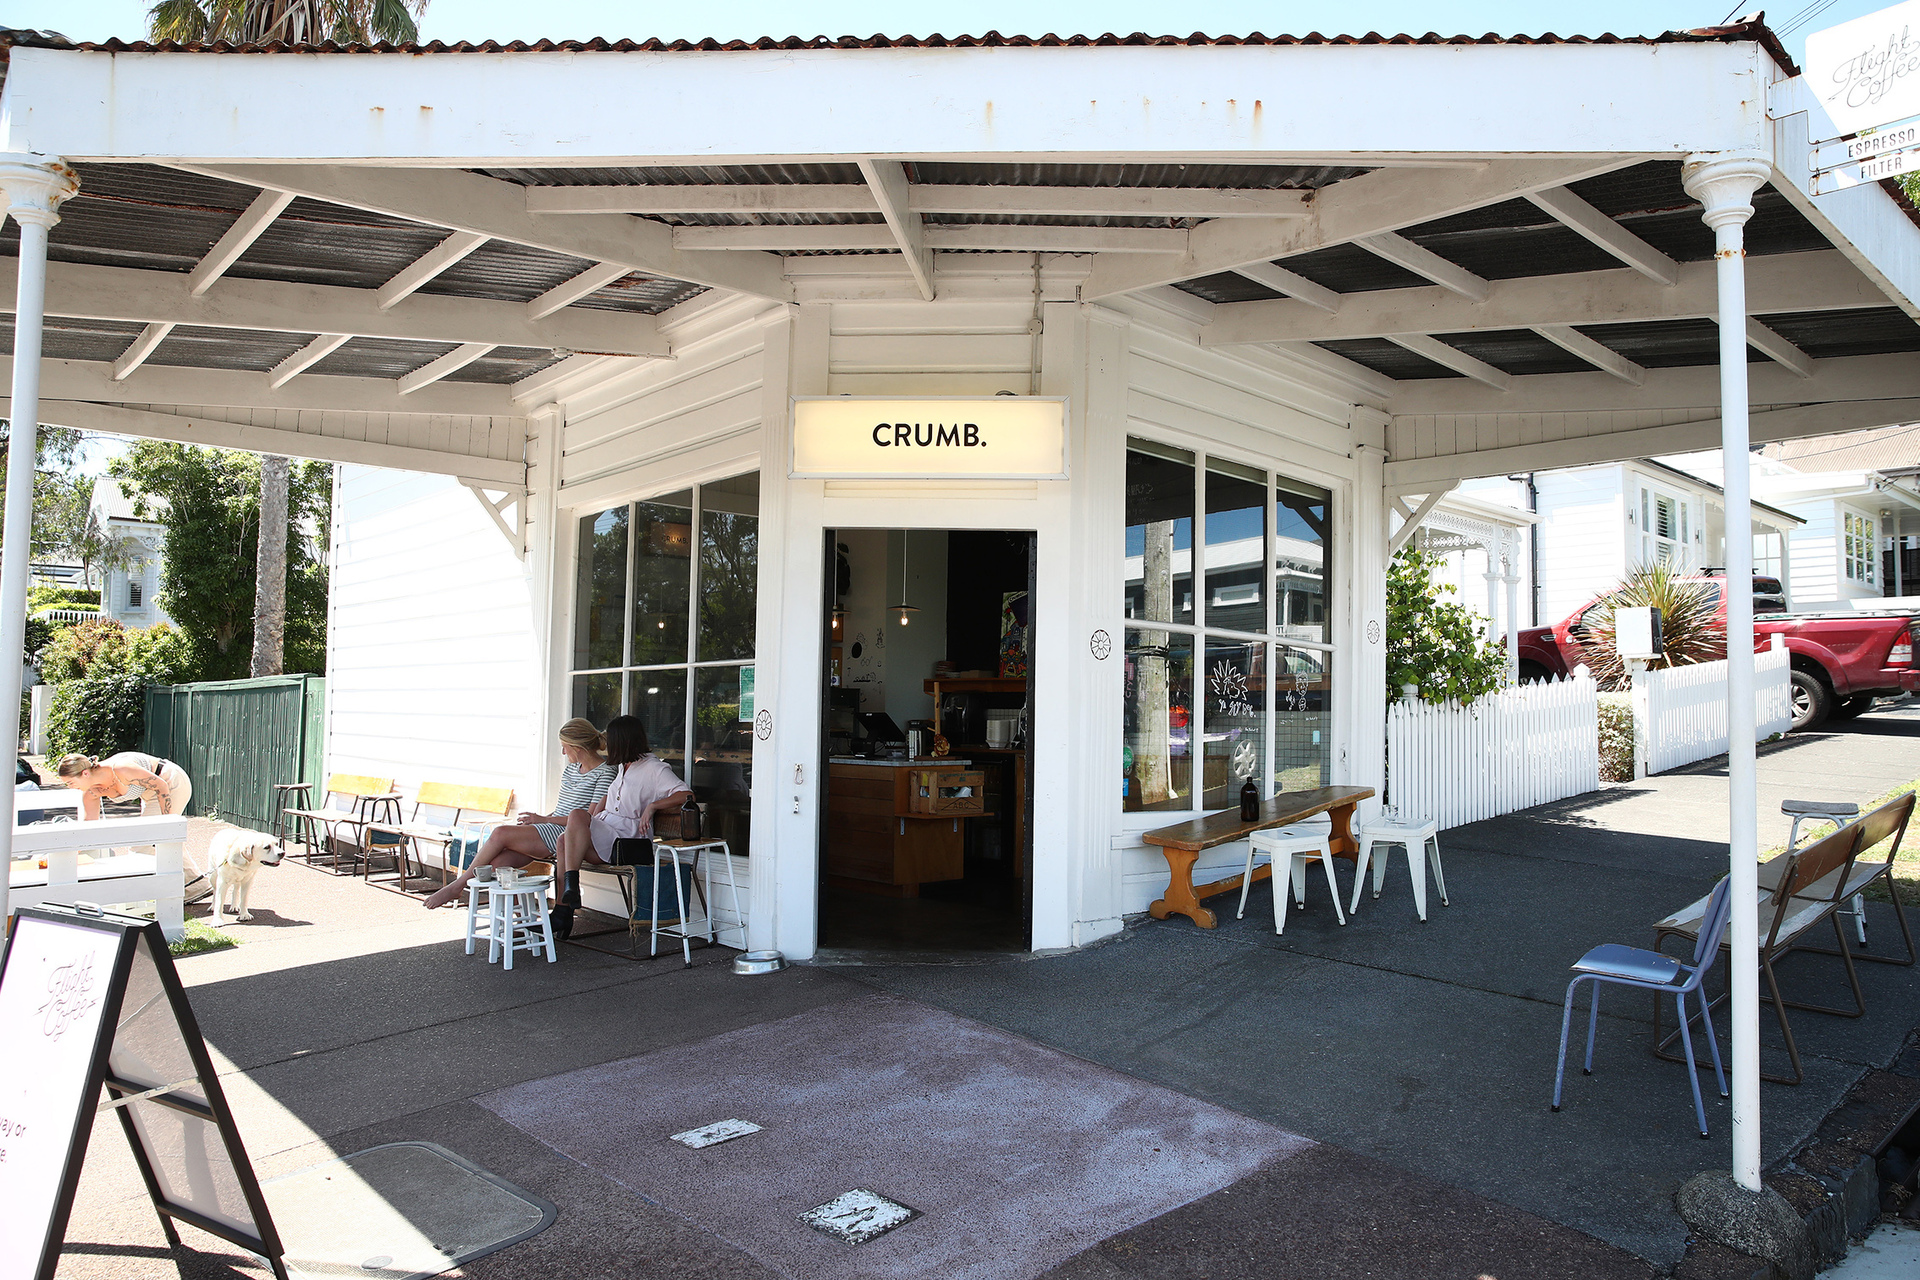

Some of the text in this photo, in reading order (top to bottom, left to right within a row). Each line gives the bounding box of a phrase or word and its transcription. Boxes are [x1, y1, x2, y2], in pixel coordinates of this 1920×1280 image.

[1829, 25, 1911, 97] Flight
[1847, 41, 1920, 108] Coffee
[1848, 128, 1915, 158] ESPRESSO
[1861, 156, 1902, 179] FILTER
[872, 422, 987, 447] CRUMB.
[15, 1124, 26, 1138] or
